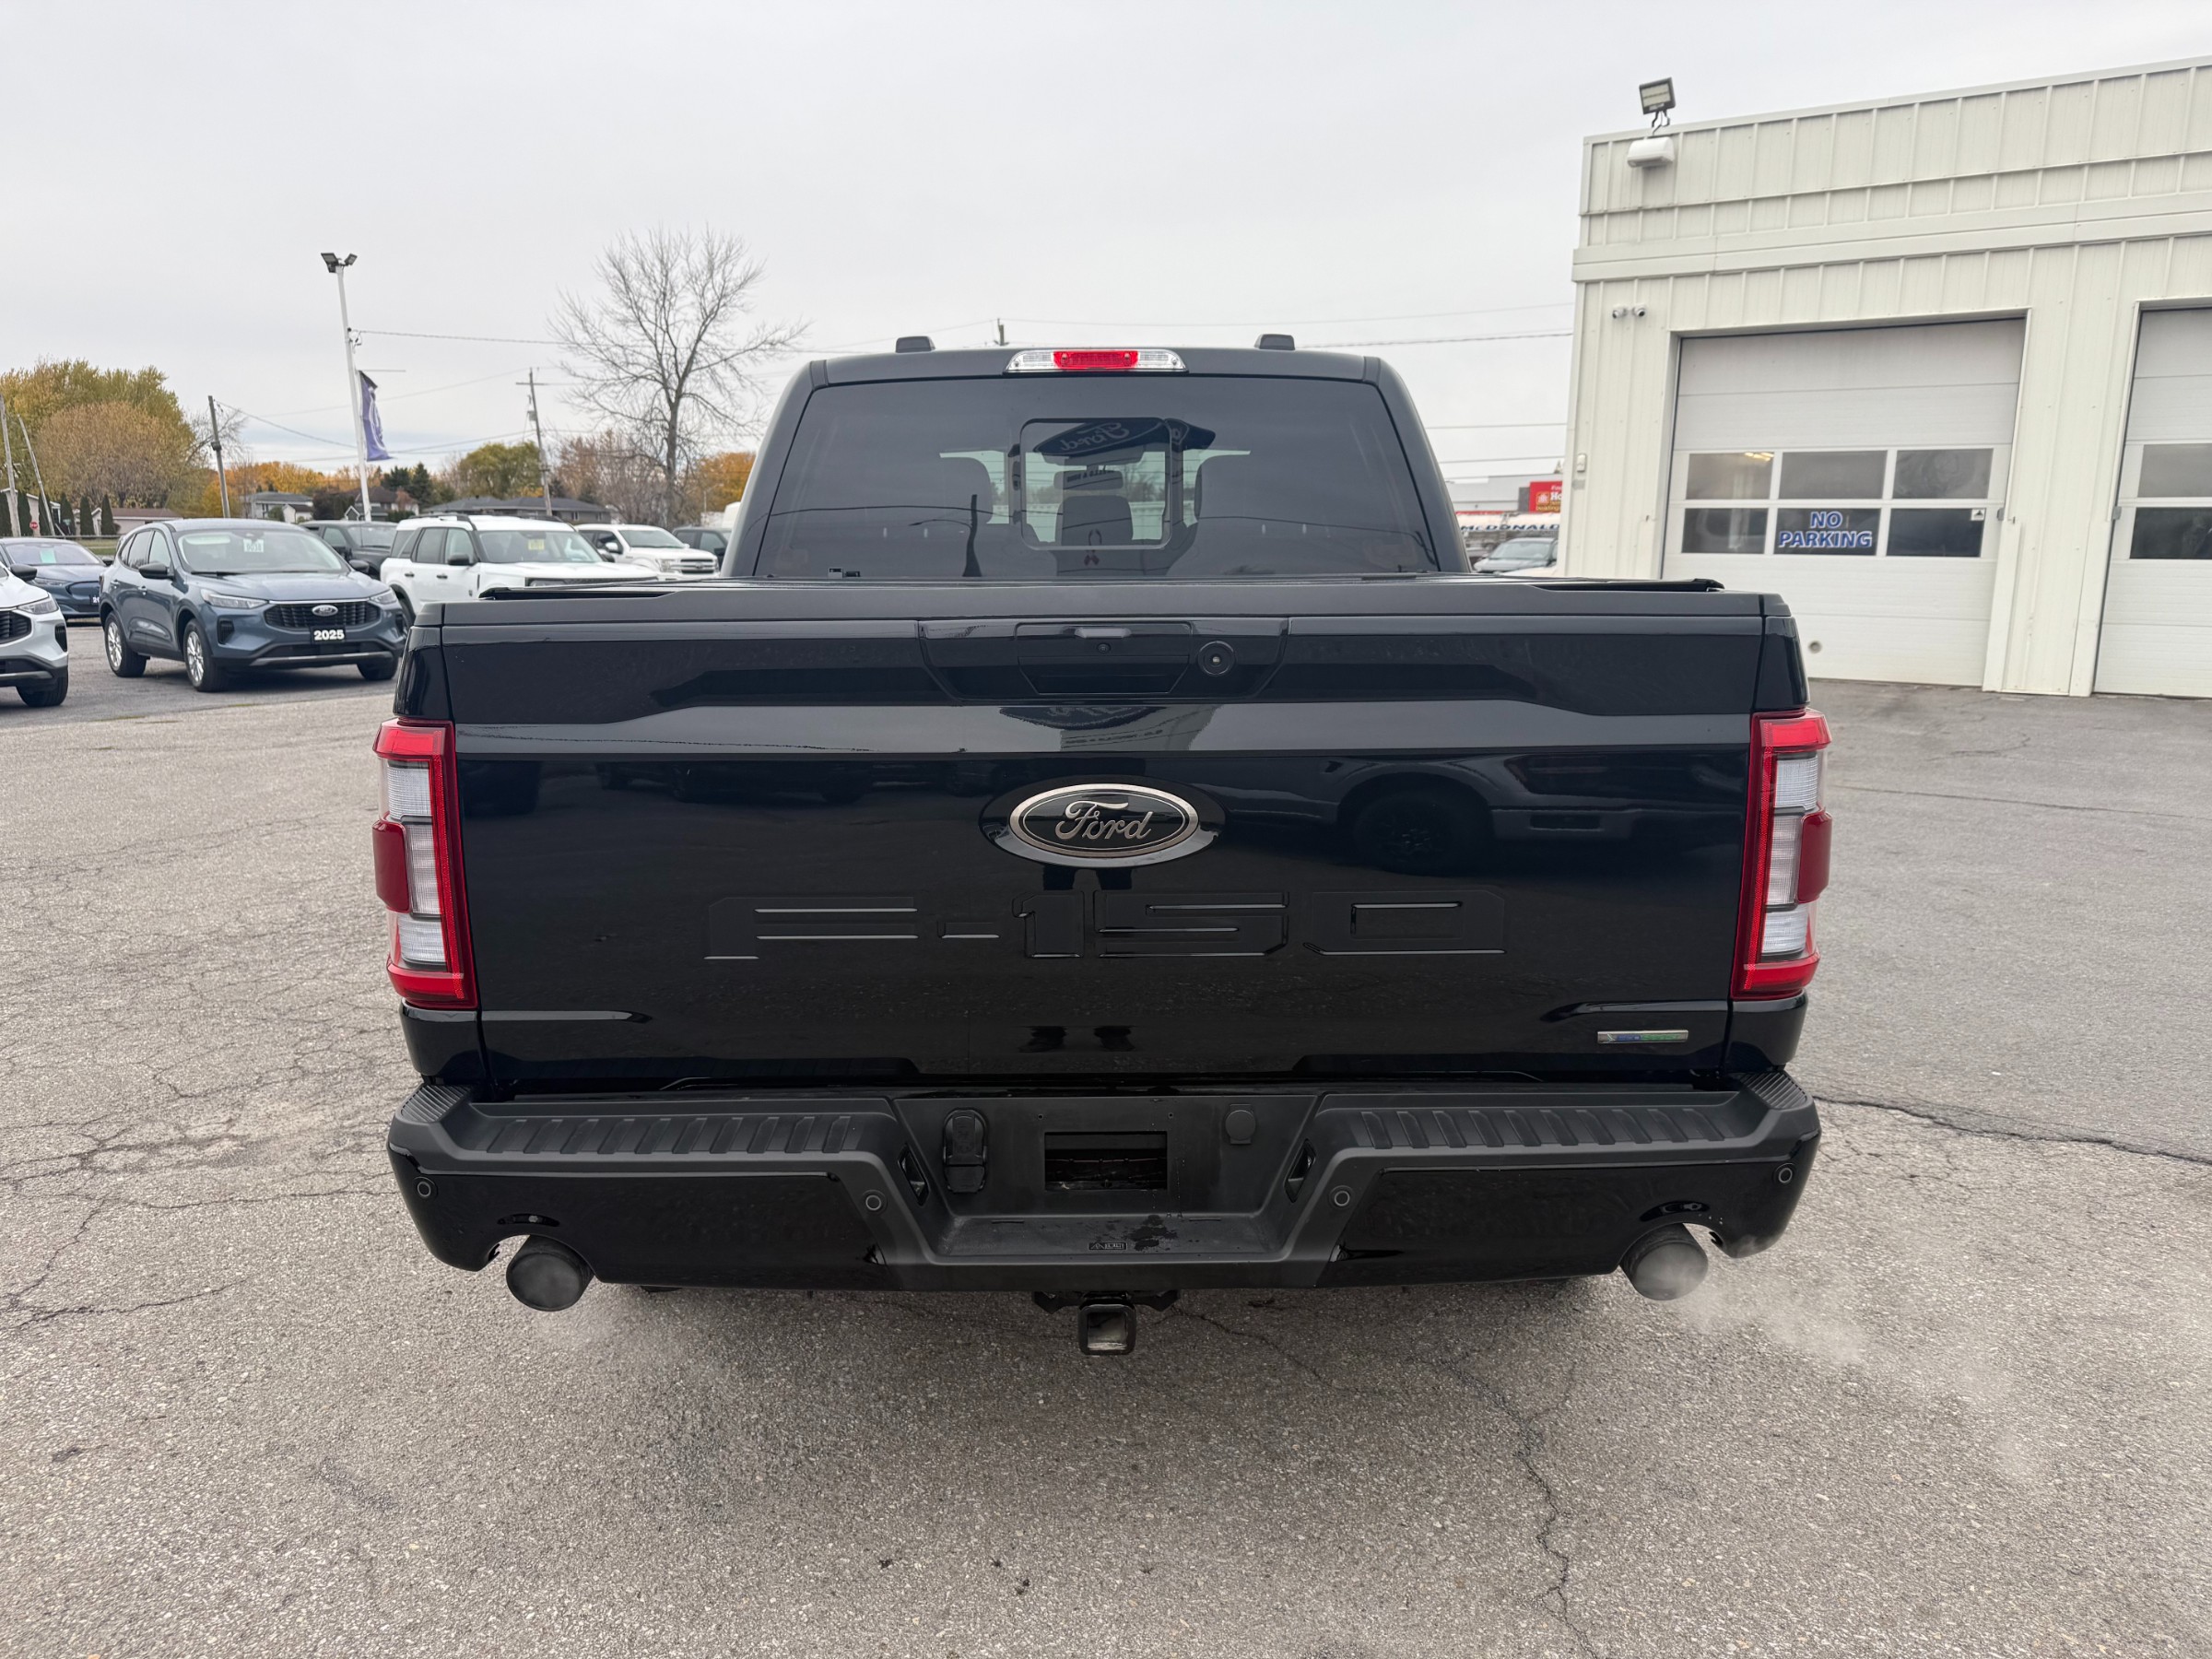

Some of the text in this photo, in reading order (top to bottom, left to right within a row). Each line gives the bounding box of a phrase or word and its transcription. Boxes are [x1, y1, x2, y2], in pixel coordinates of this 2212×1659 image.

[1810, 511, 1843, 529] NO
[1778, 530, 1873, 548] PARKING
[313, 629, 345, 641] 2025
[1054, 800, 1154, 841] Ford
[704, 889, 1507, 959] F-150
